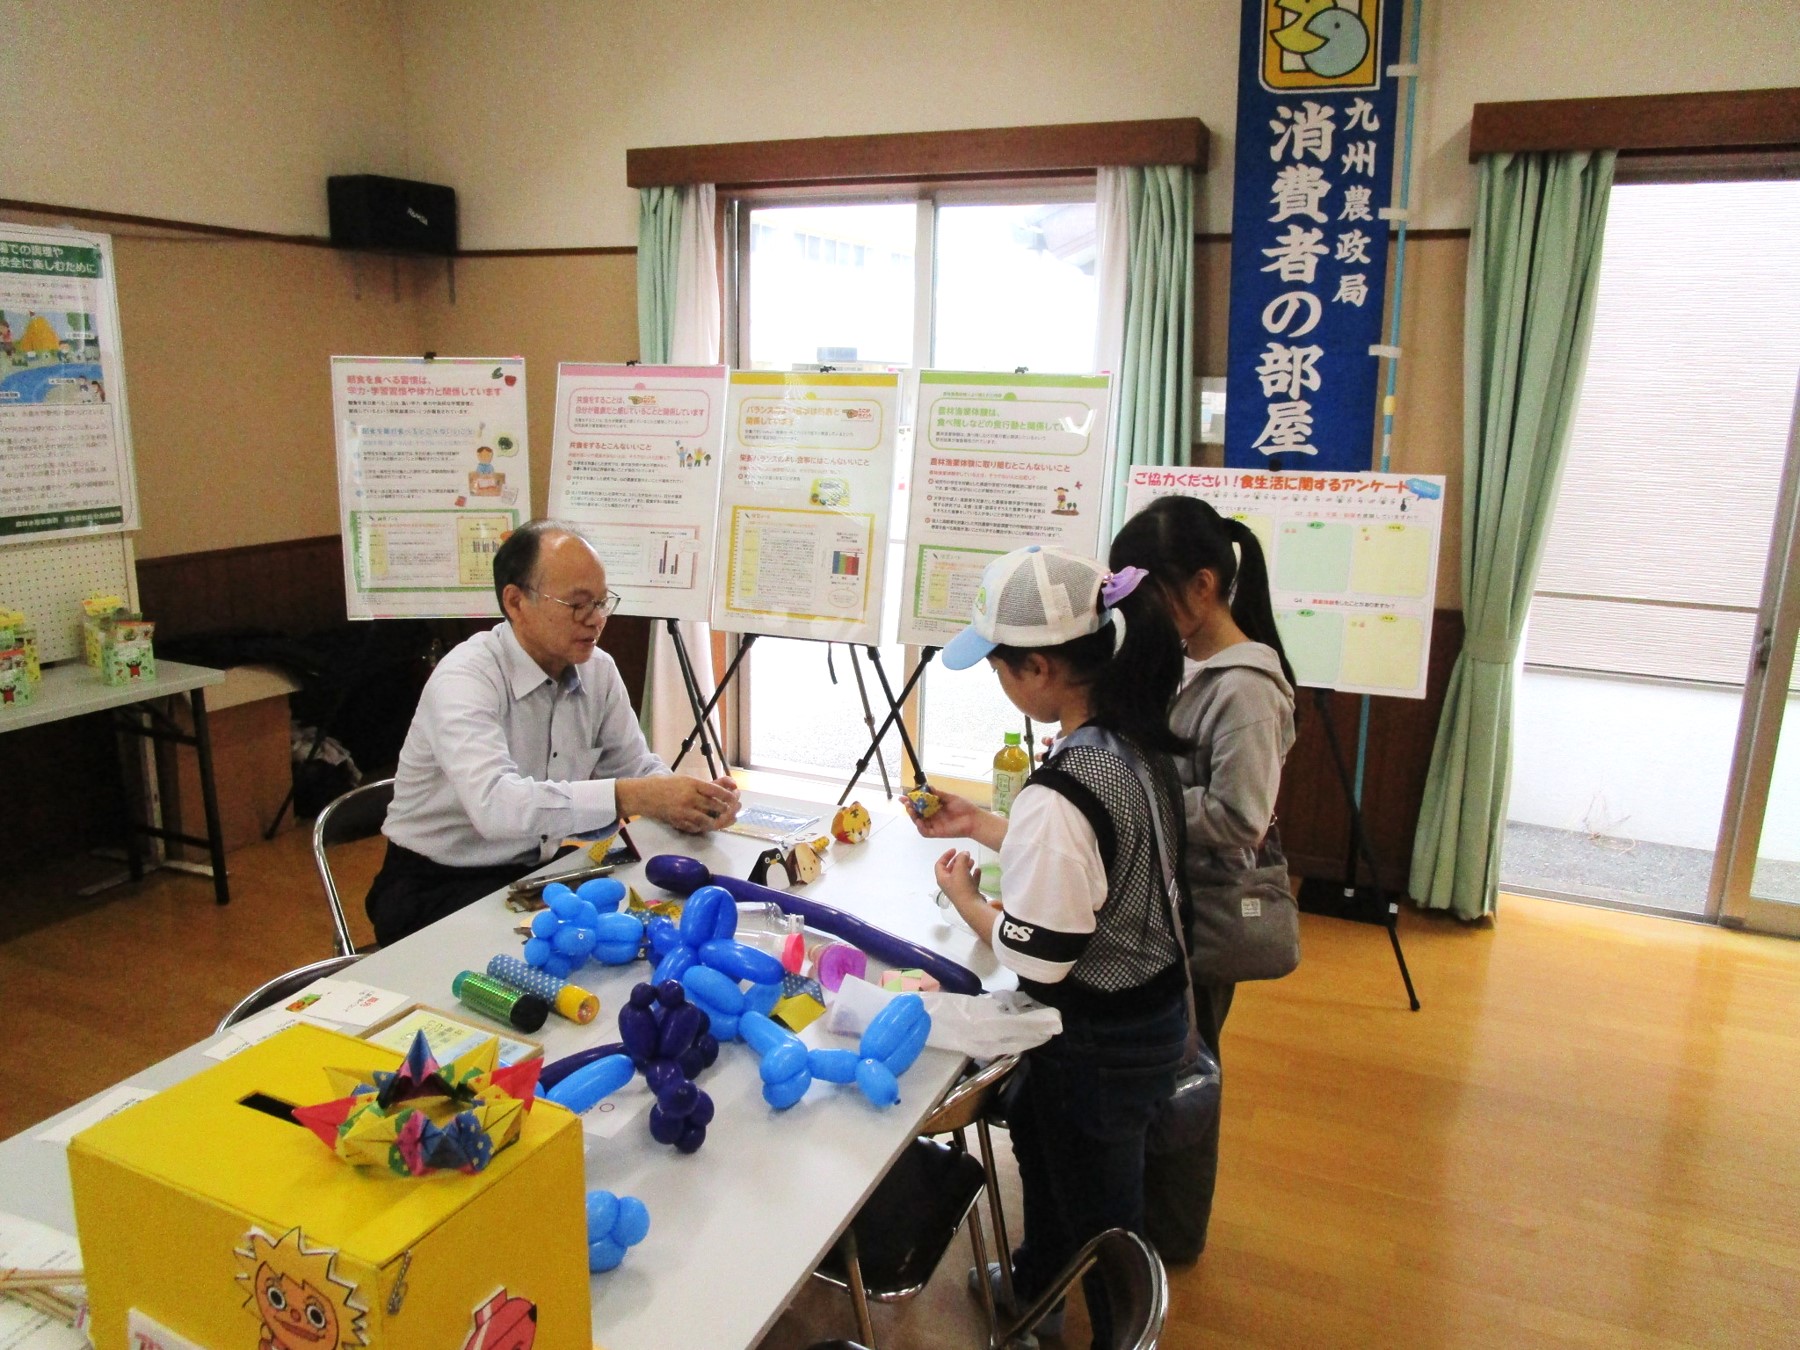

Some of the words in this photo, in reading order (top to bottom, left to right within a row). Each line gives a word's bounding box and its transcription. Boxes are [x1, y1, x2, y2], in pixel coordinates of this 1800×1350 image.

[1251, 100, 1337, 457] 消費者の部屋
[1331, 97, 1380, 308] 九州農政局
